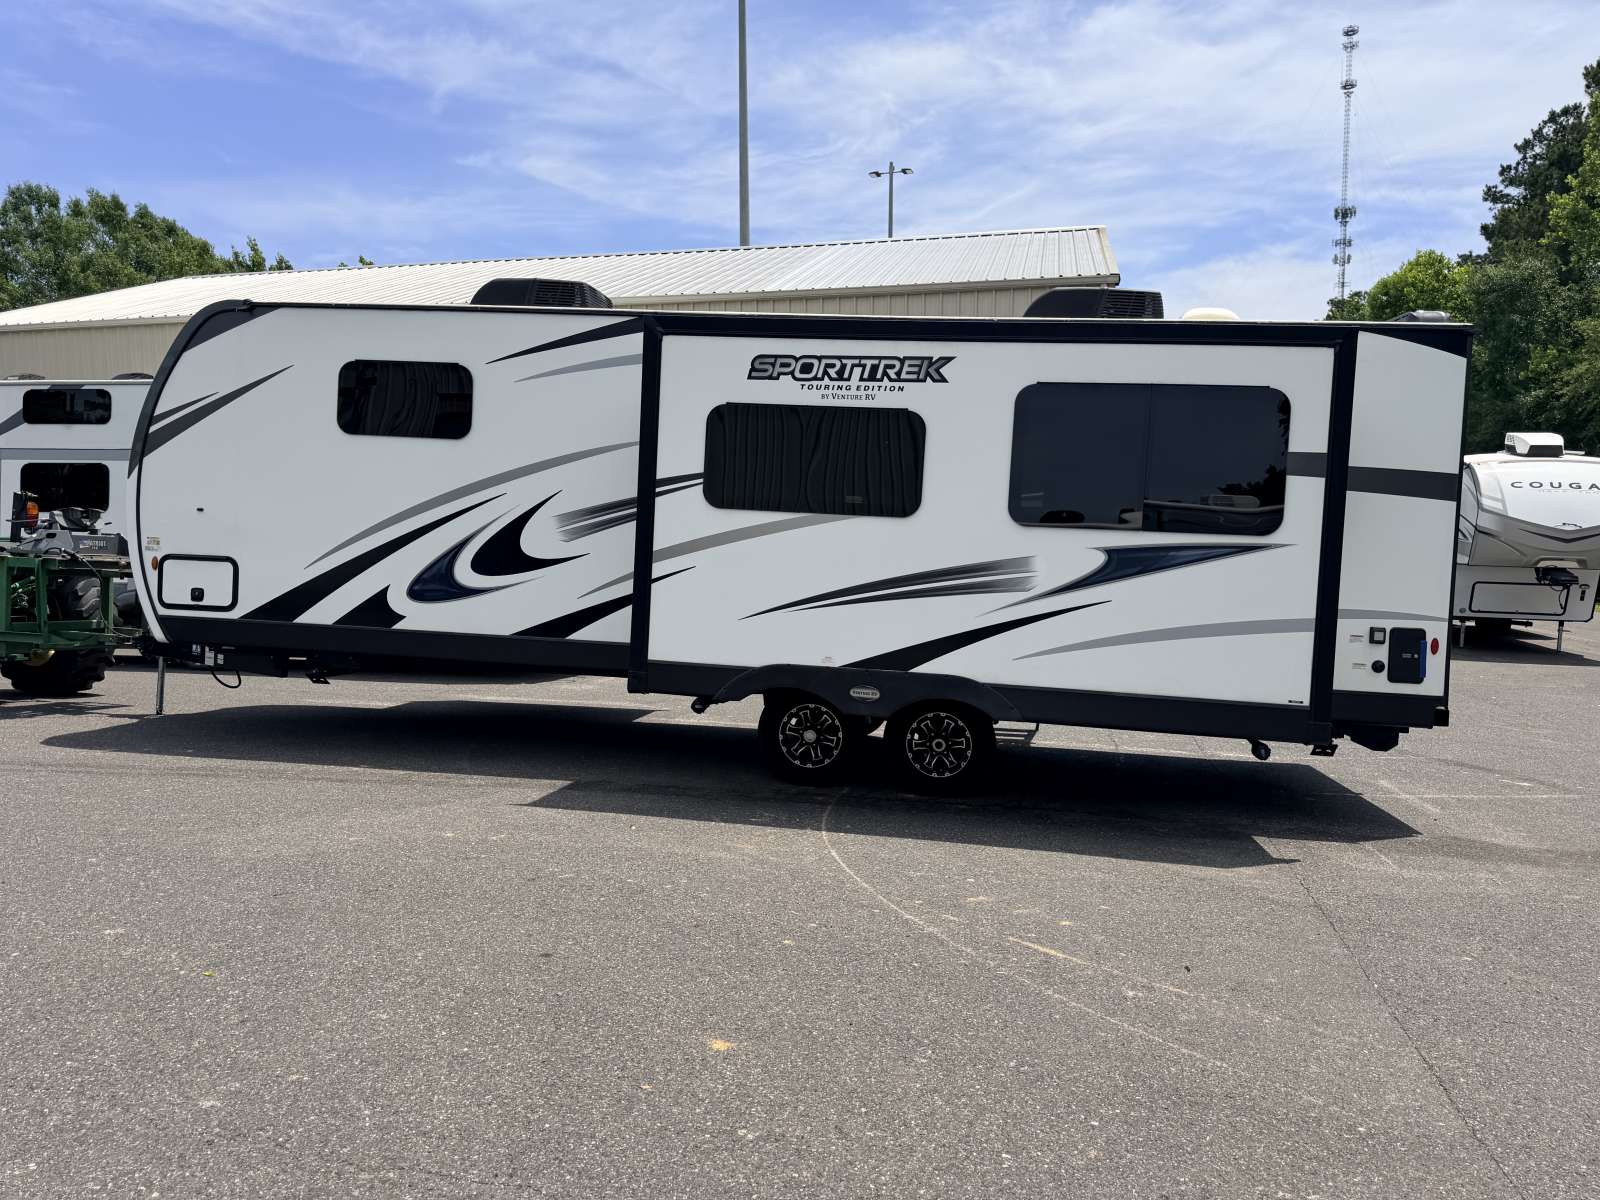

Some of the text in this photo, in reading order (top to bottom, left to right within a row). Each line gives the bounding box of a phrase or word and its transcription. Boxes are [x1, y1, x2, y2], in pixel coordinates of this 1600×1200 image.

[747, 354, 957, 383] SPORTTREK
[800, 383, 852, 391] TOURING
[1510, 481, 1600, 491] COUGA
